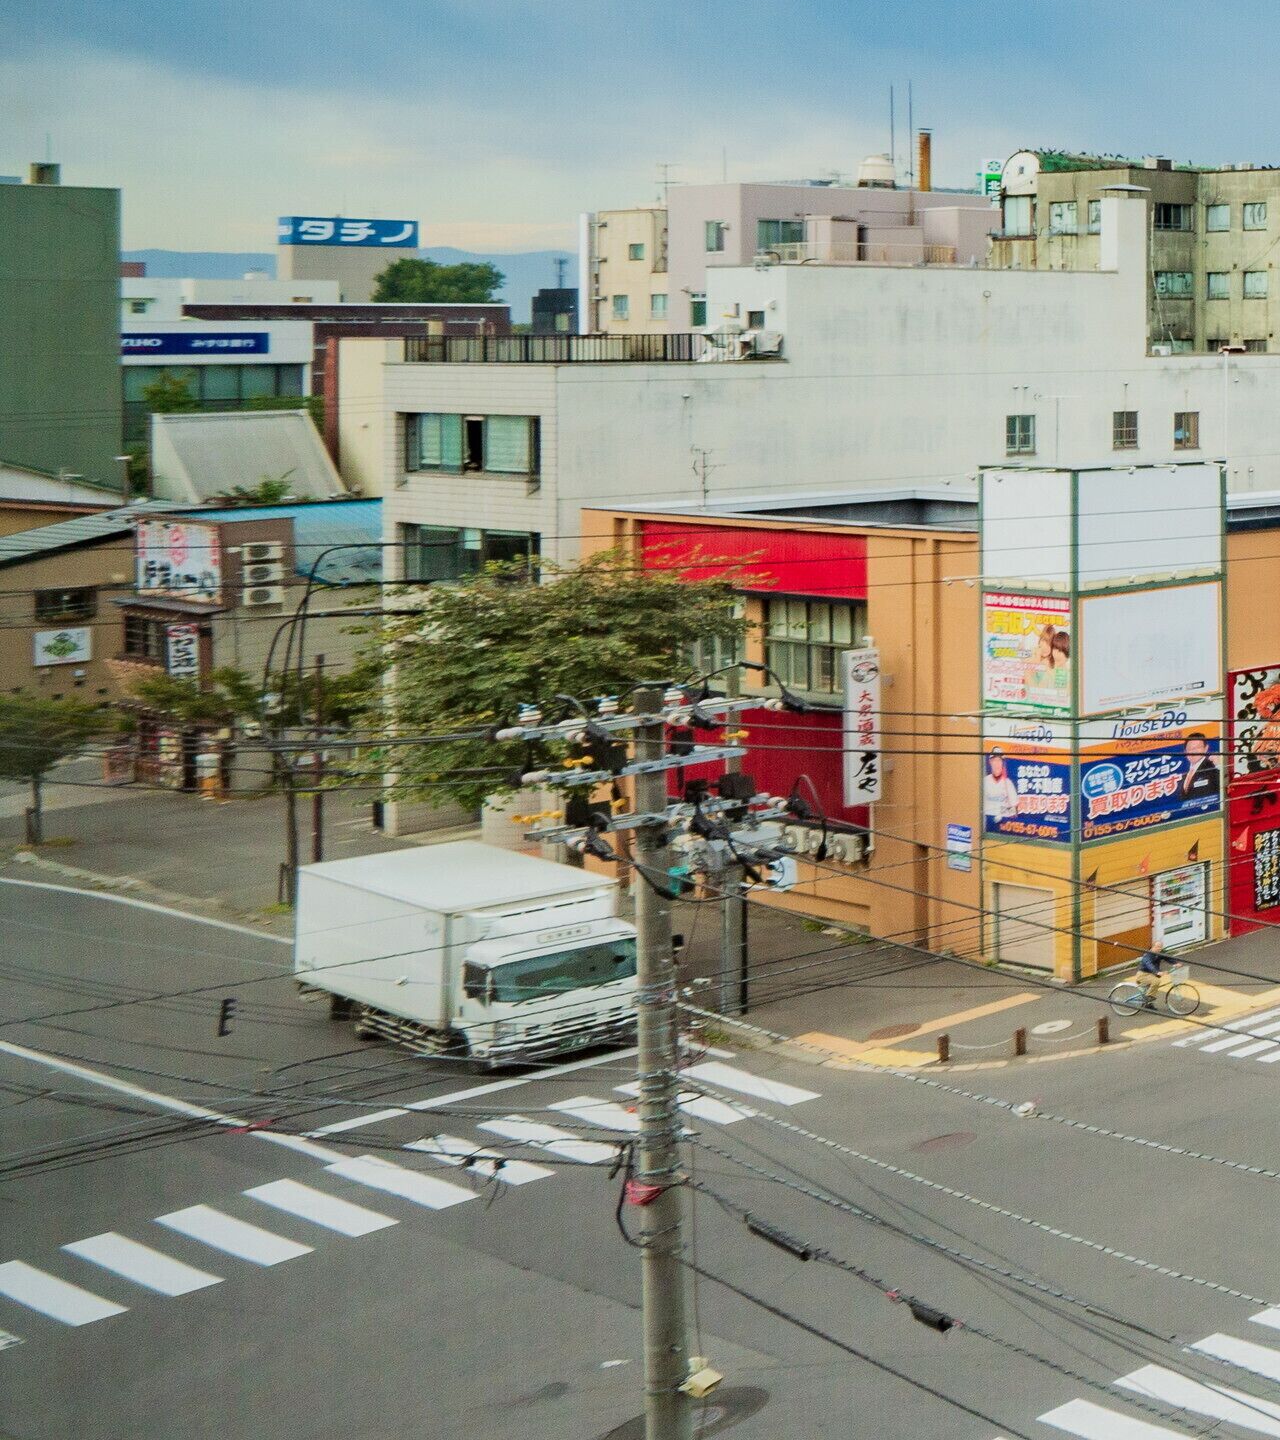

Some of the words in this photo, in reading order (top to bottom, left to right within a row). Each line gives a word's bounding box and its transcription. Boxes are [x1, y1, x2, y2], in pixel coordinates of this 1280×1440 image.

[299, 220, 413, 243] タチノ
[191, 338, 256, 349] みずほ銀行
[853, 751, 878, 794] 庄や
[1125, 754, 1172, 773] アパート
[1125, 760, 1183, 784] マンション
[1017, 793, 1070, 814] 買取ります
[1087, 773, 1183, 819] 買取ります
